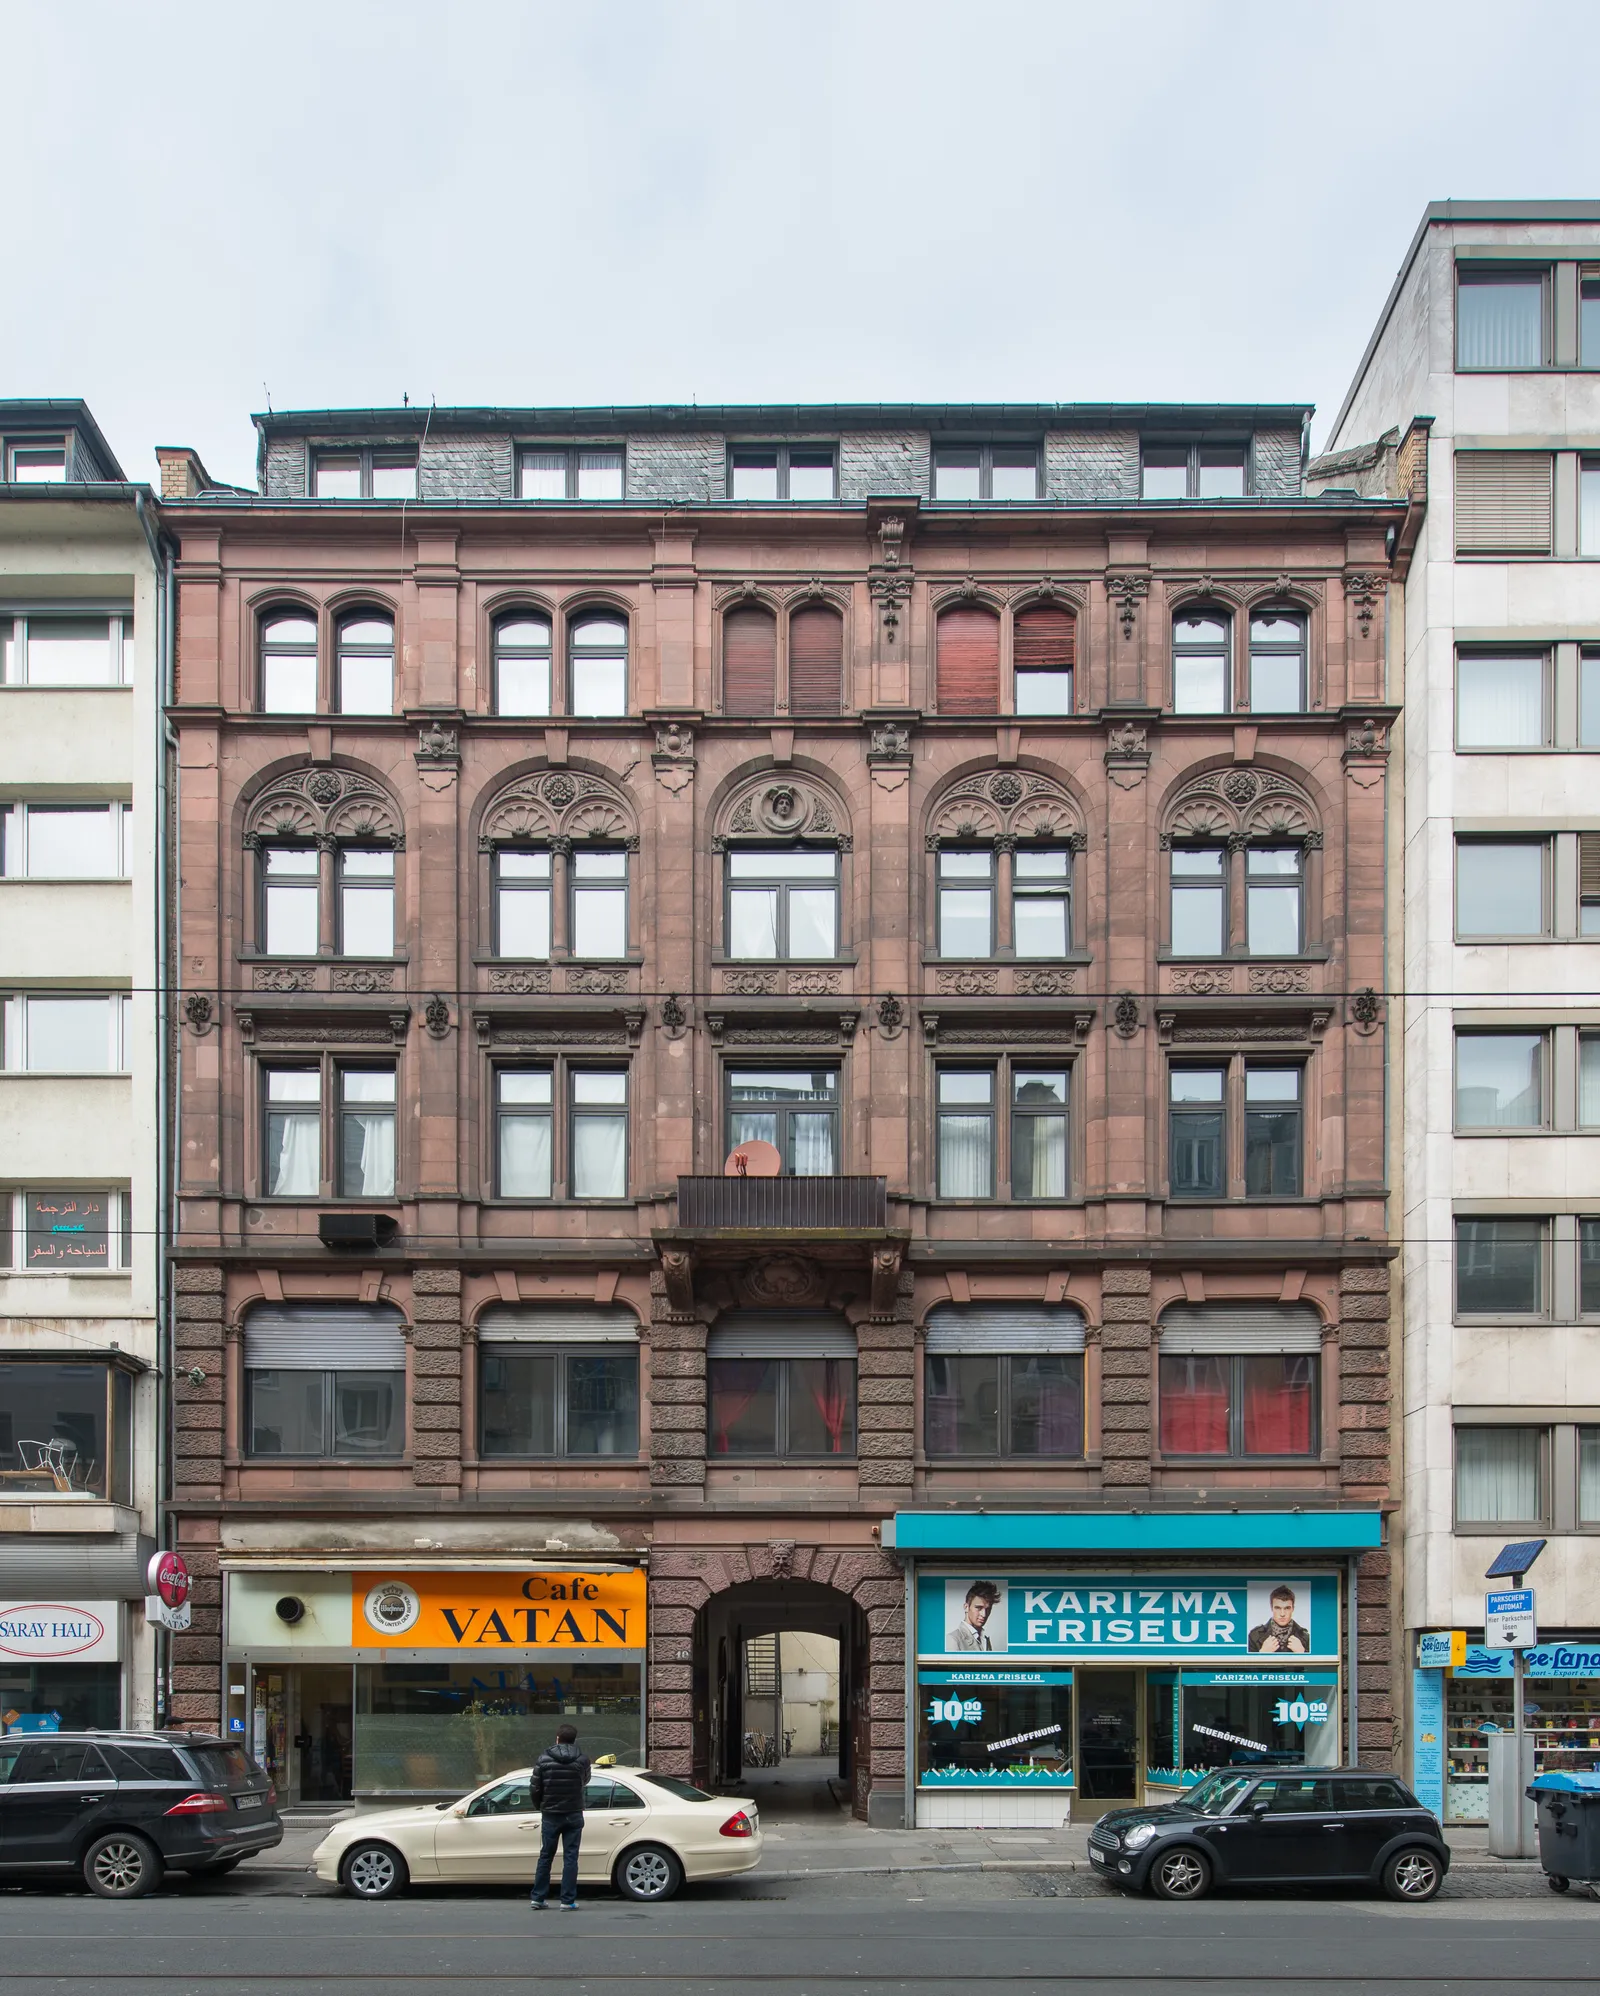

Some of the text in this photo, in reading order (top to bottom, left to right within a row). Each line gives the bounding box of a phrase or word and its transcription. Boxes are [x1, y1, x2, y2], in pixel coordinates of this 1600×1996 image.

[82, 1201, 99, 1215] دار
[522, 1577, 599, 1601] Cafe
[1024, 1591, 1238, 1615] KARIZMA
[1496, 1602, 1523, 1611] AUTOMAT
[0, 1620, 48, 1638] SARAY
[439, 1608, 631, 1643] VATAN
[1501, 1614, 1532, 1622] Parkschein
[1026, 1618, 1236, 1643] FRISEUR
[986, 1724, 1062, 1752] NEUERÖFFNUNG
[1192, 1723, 1268, 1752] NEUERÖFFNUNG
